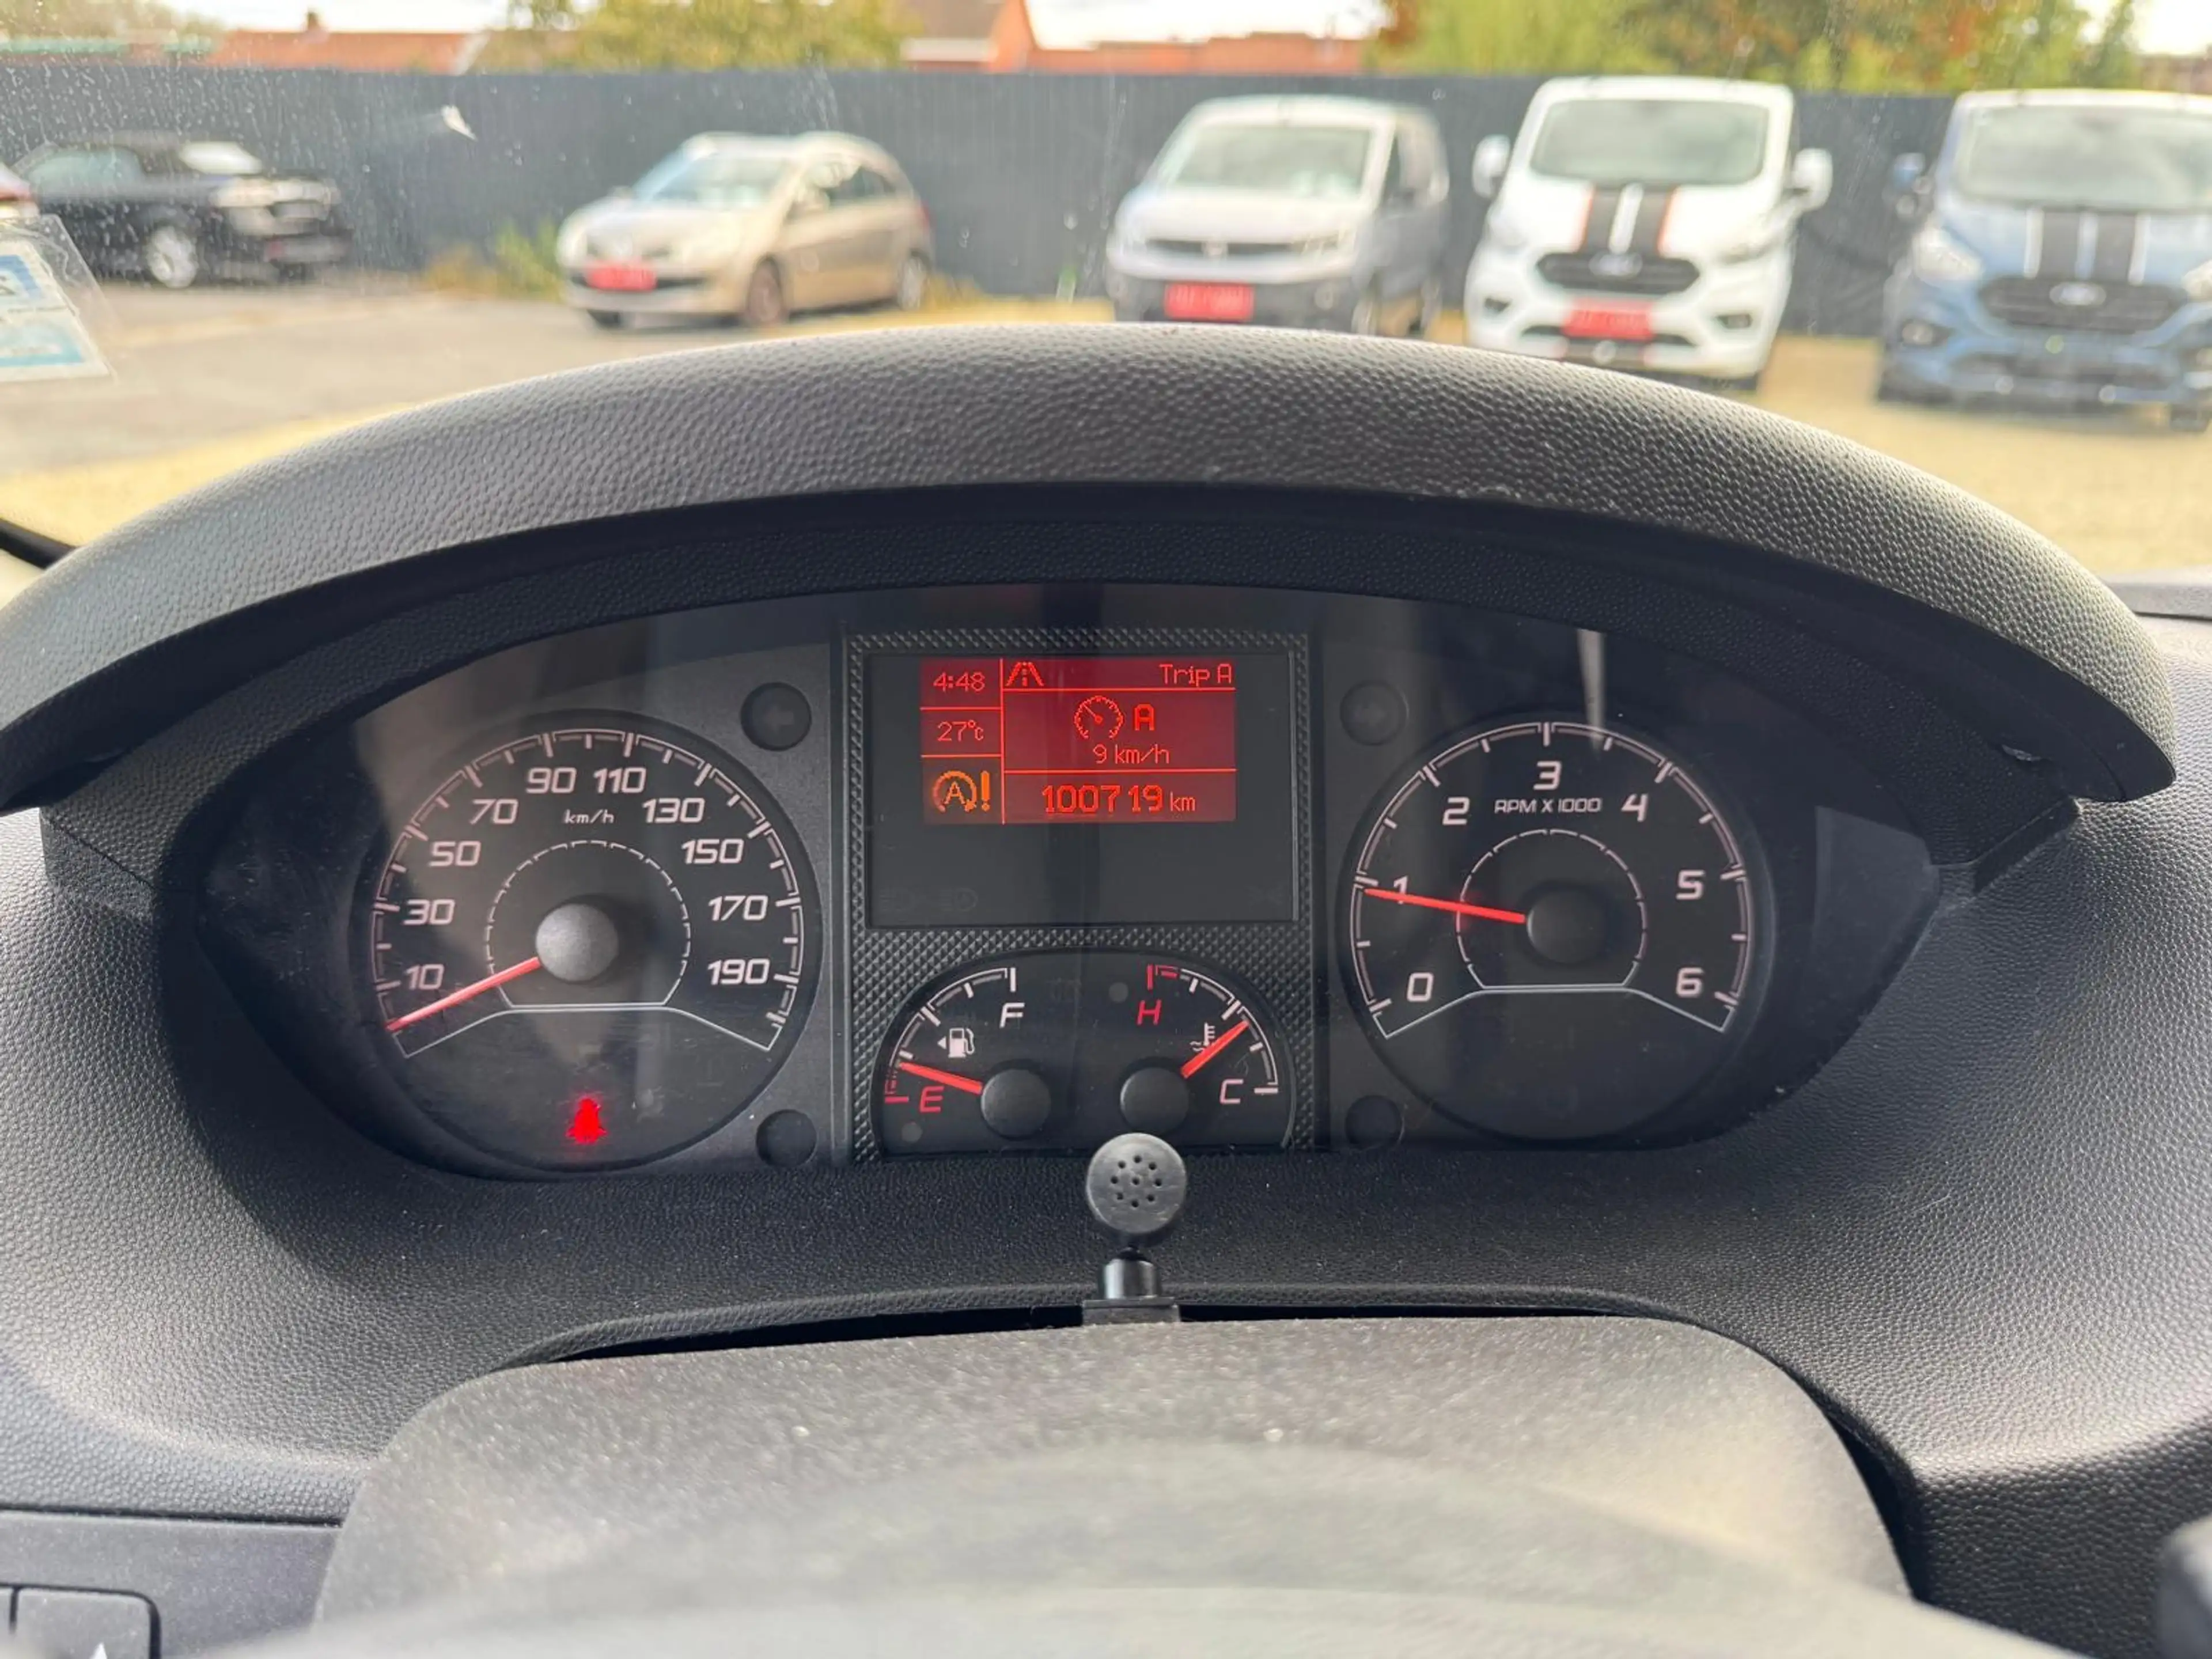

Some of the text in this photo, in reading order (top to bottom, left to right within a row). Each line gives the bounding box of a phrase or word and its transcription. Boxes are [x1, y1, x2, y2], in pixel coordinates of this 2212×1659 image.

[933, 672, 986, 692] 4:48
[1159, 663, 1233, 687] Trip A
[1133, 703, 1154, 731] A
[1093, 744, 1170, 764] 9 km/h
[526, 767, 576, 794] 90
[593, 767, 646, 794] 110
[1533, 760, 1562, 790] 3
[469, 798, 518, 824] 70
[643, 797, 705, 823] 130
[1041, 785, 1196, 814] 100719 km
[1442, 797, 1470, 825] 2
[1494, 797, 1601, 813] RPM X 1000
[1622, 794, 1648, 821] 4
[564, 809, 615, 824] km/h
[429, 840, 482, 868] 50
[681, 839, 744, 865] 150
[1676, 870, 1705, 900] 5
[403, 899, 456, 925] 30
[707, 895, 768, 921] 170
[406, 964, 445, 990] 10
[707, 959, 770, 986] 190
[1675, 968, 1705, 997] 6
[1407, 972, 1434, 1002] 0
[1000, 1002, 1025, 1028] F
[1138, 1000, 1162, 1025] H
[919, 1086, 944, 1112] E
[1219, 1079, 1244, 1103] C
